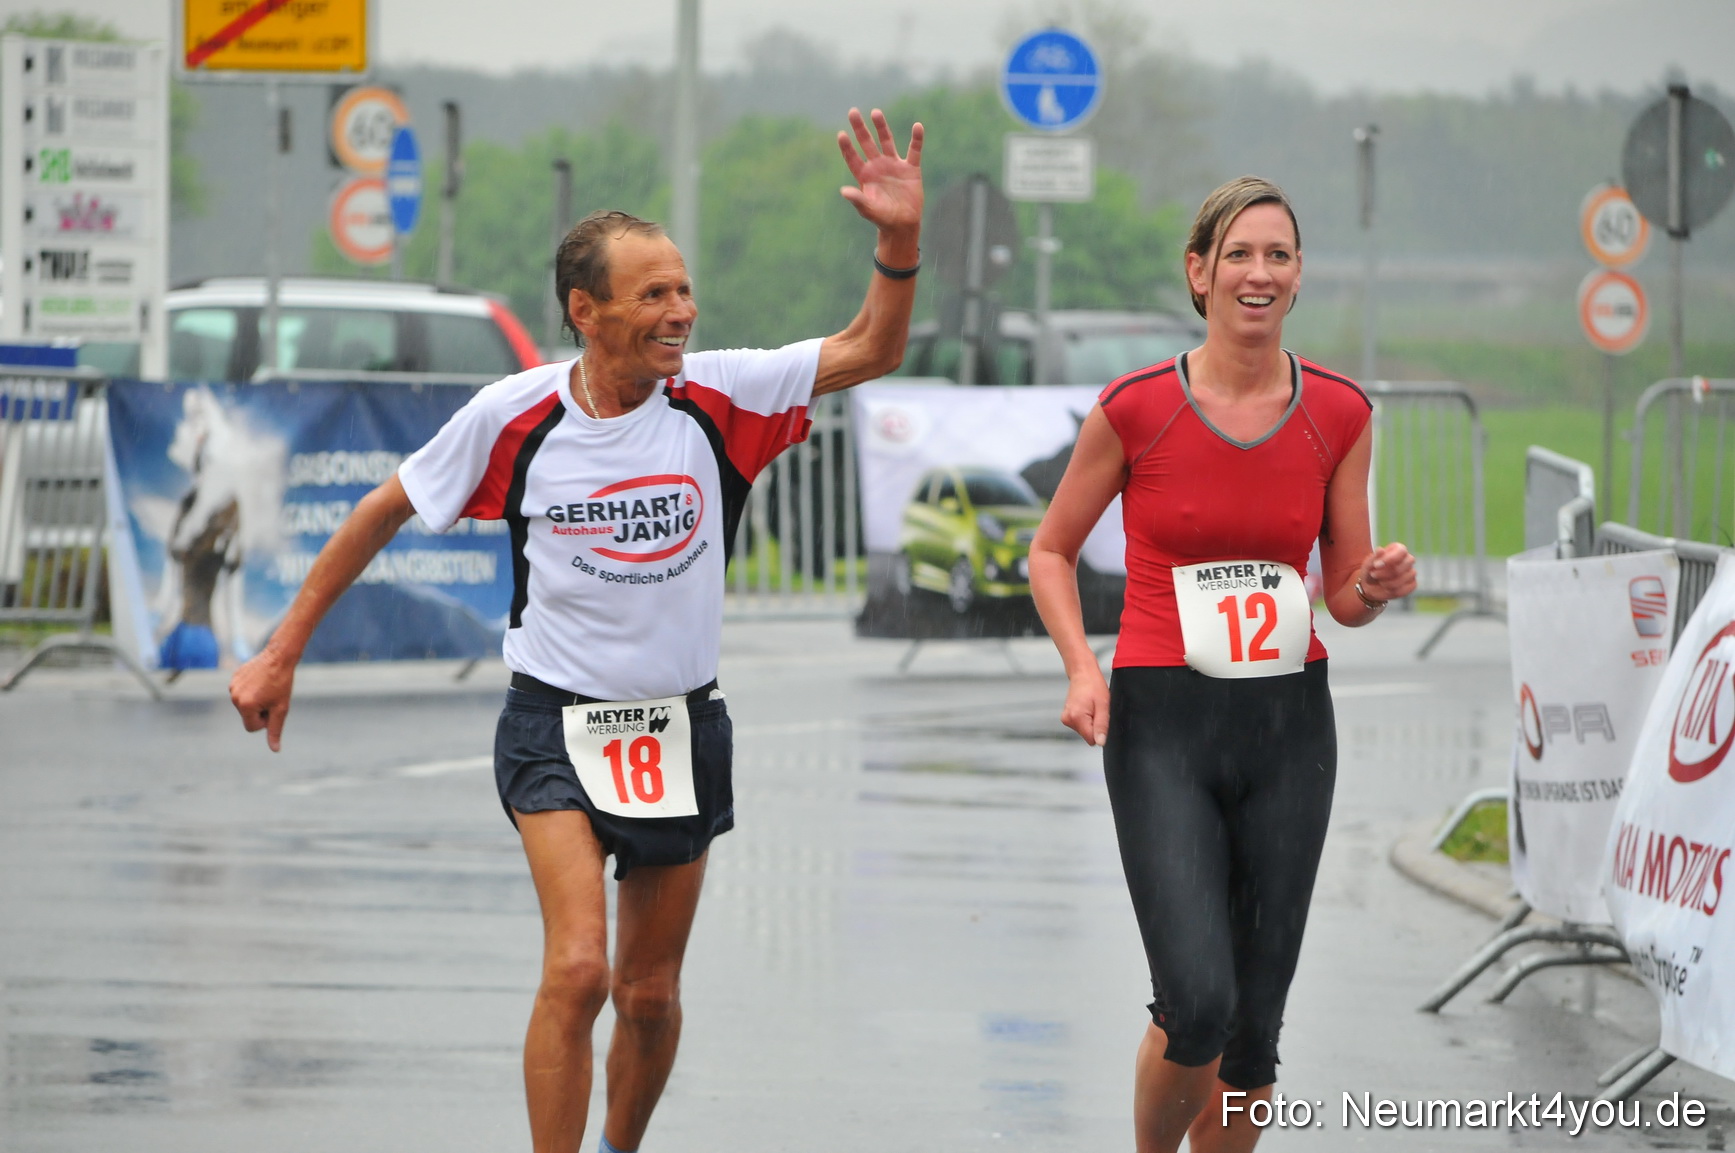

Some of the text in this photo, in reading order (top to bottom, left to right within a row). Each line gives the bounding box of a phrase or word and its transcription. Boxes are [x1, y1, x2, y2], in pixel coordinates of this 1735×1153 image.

[545, 493, 681, 523] GERHART
[552, 525, 614, 536] Autohaus
[571, 539, 709, 585] Das sportliche Autohaus
[1196, 564, 1256, 583] MEYER
[1197, 578, 1258, 591] WERBUNG
[1217, 592, 1280, 663] 12
[586, 708, 644, 725] MEYER
[586, 722, 645, 735] WERBUNG
[603, 735, 665, 804] 18
[1580, 779, 1600, 802] IST
[1613, 820, 1640, 891] KIA
